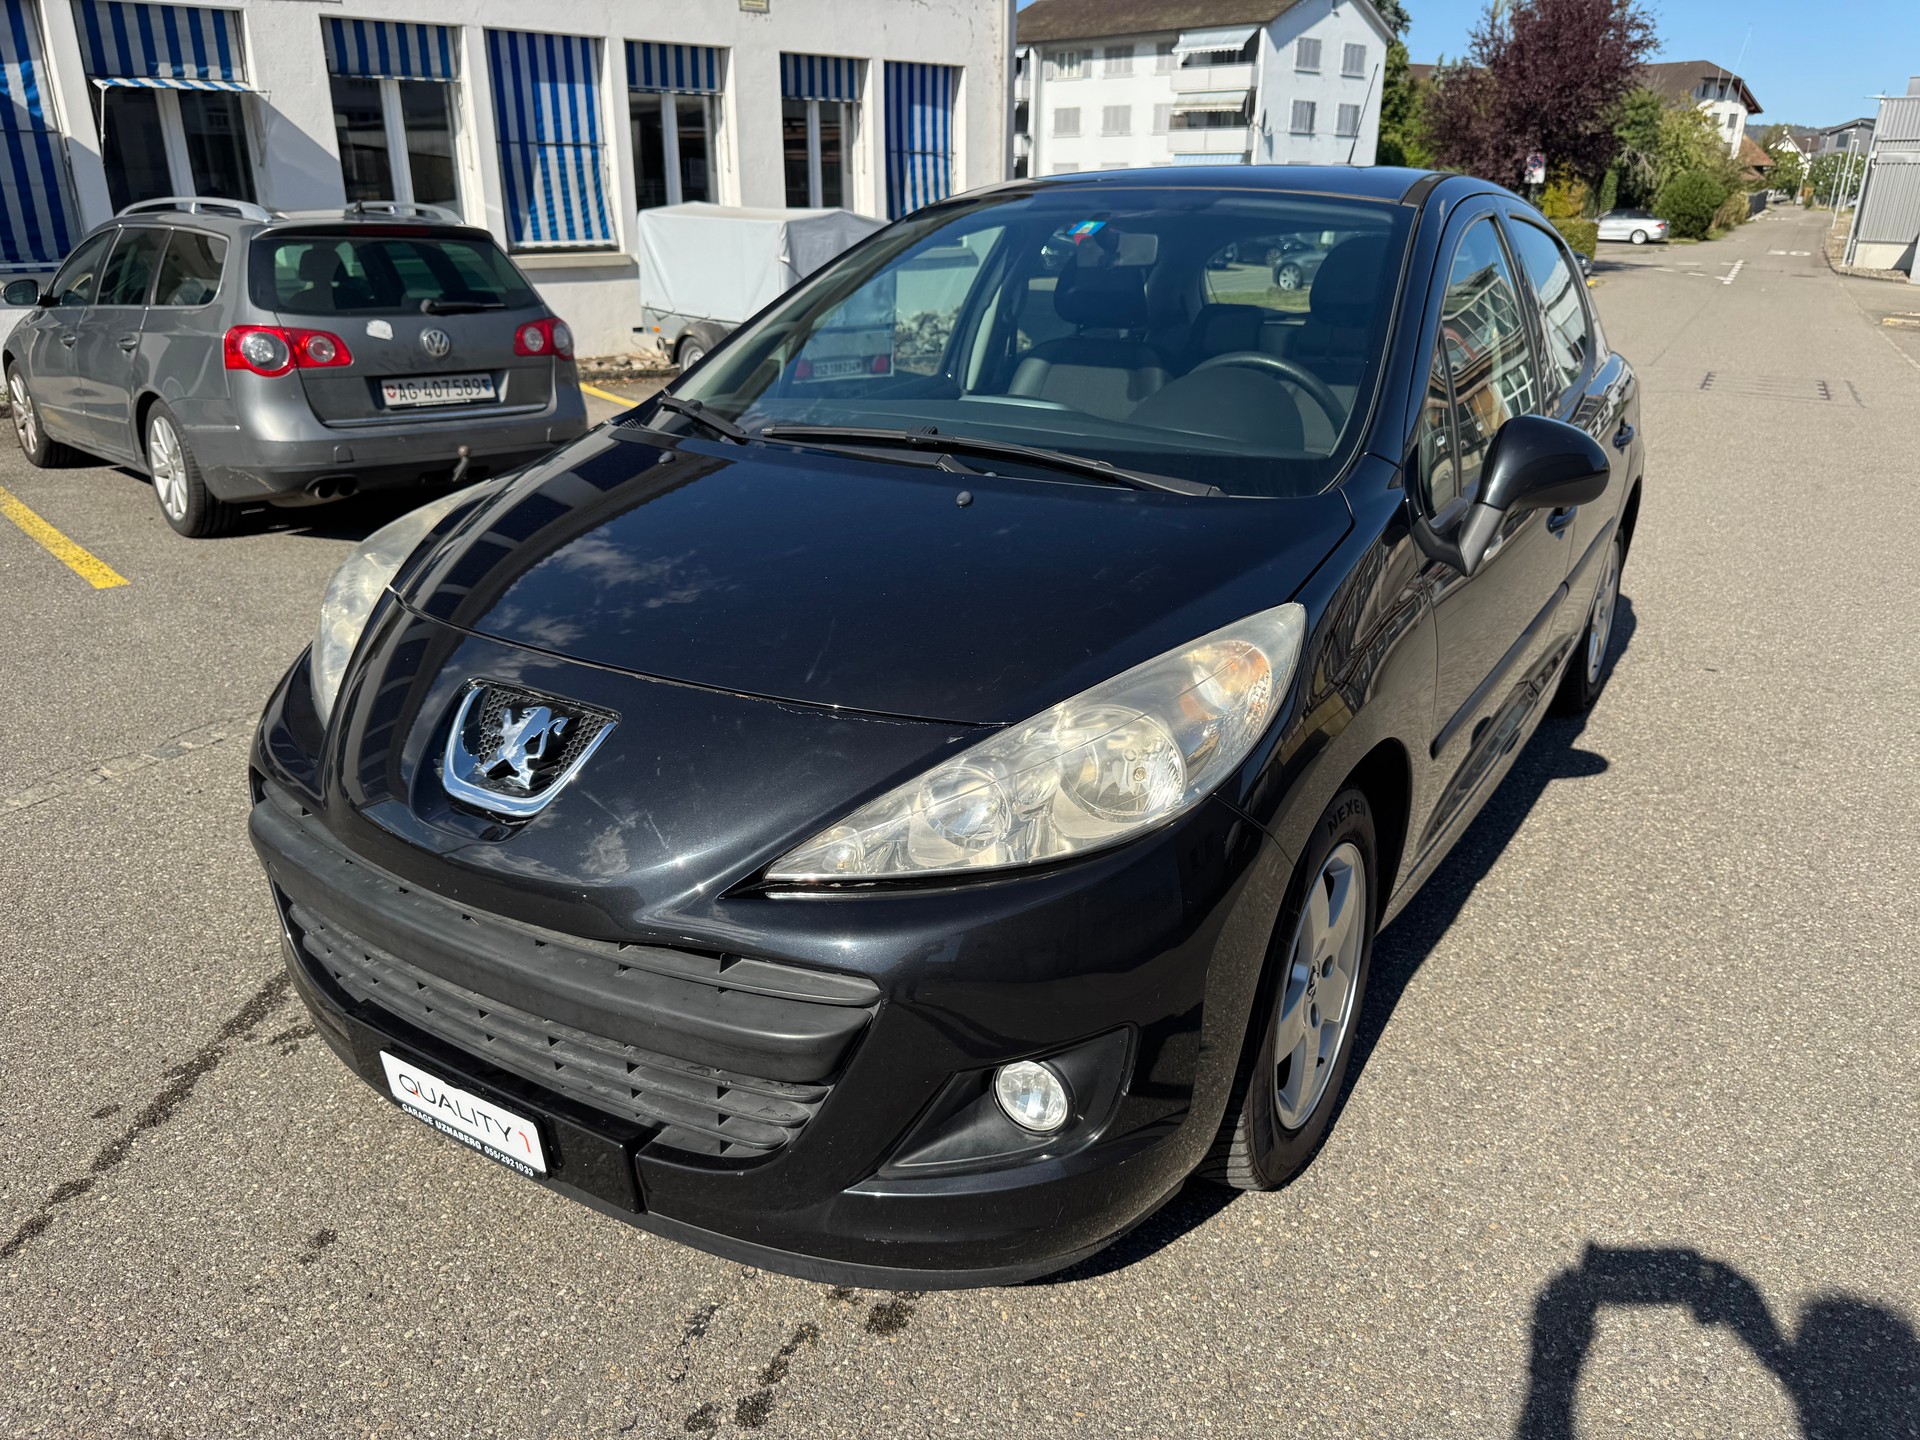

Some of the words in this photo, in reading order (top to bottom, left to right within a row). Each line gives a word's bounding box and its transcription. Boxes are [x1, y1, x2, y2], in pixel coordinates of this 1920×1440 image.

[1327, 798, 1366, 837] NEXEN
[399, 1074, 511, 1142] QUALITY
[402, 1103, 434, 1127] GARAGE
